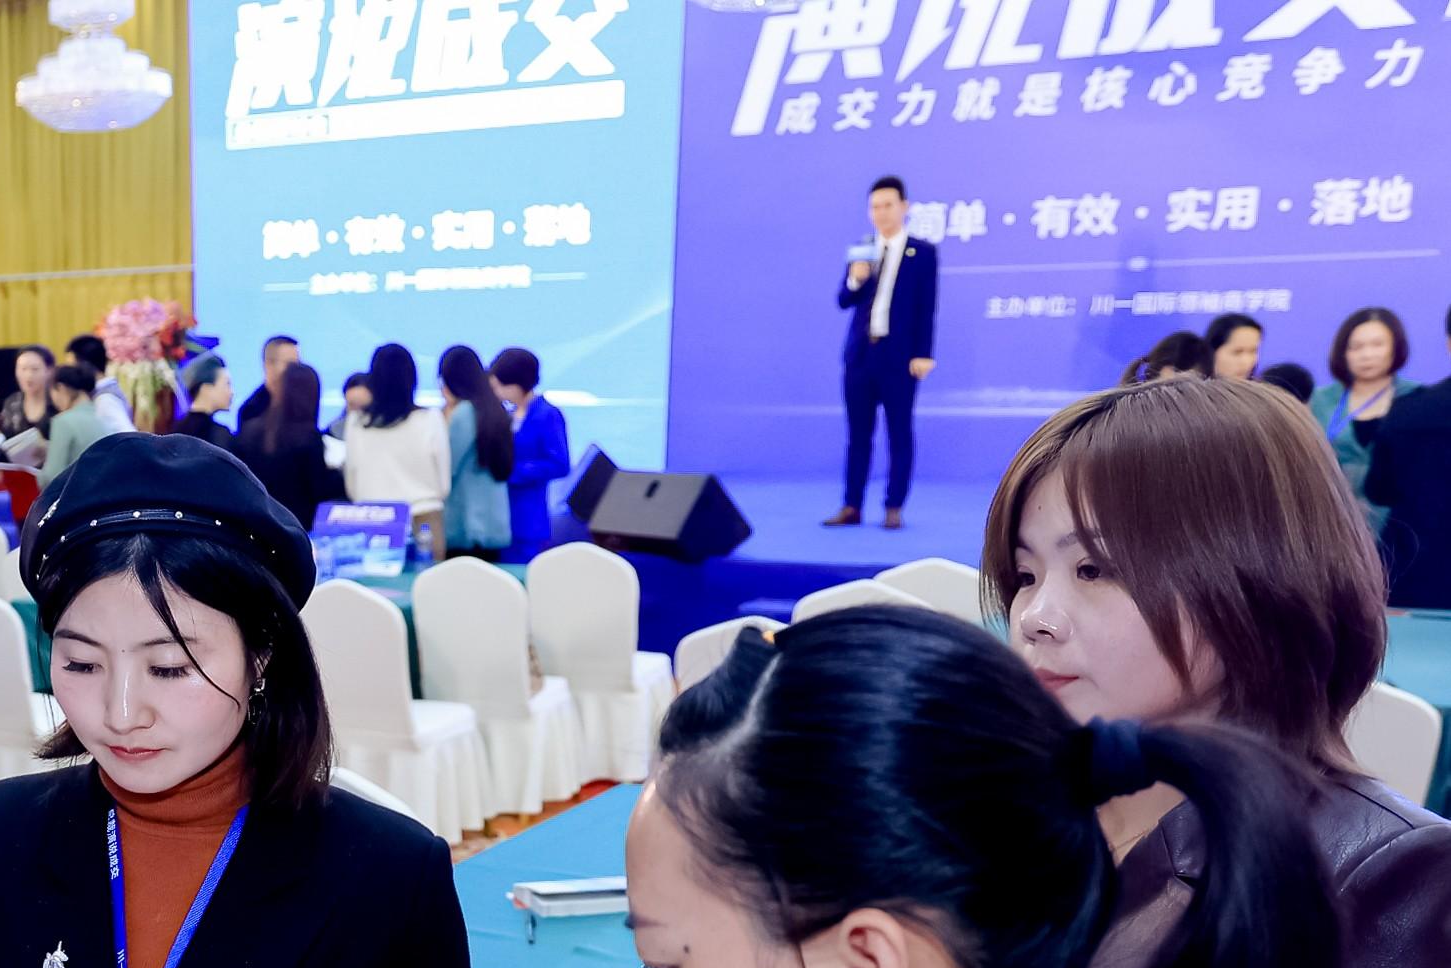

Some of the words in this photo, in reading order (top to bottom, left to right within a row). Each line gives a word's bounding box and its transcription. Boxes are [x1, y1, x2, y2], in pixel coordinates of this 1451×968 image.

[775, 38, 1425, 136] 成交力就是核心竞争力
